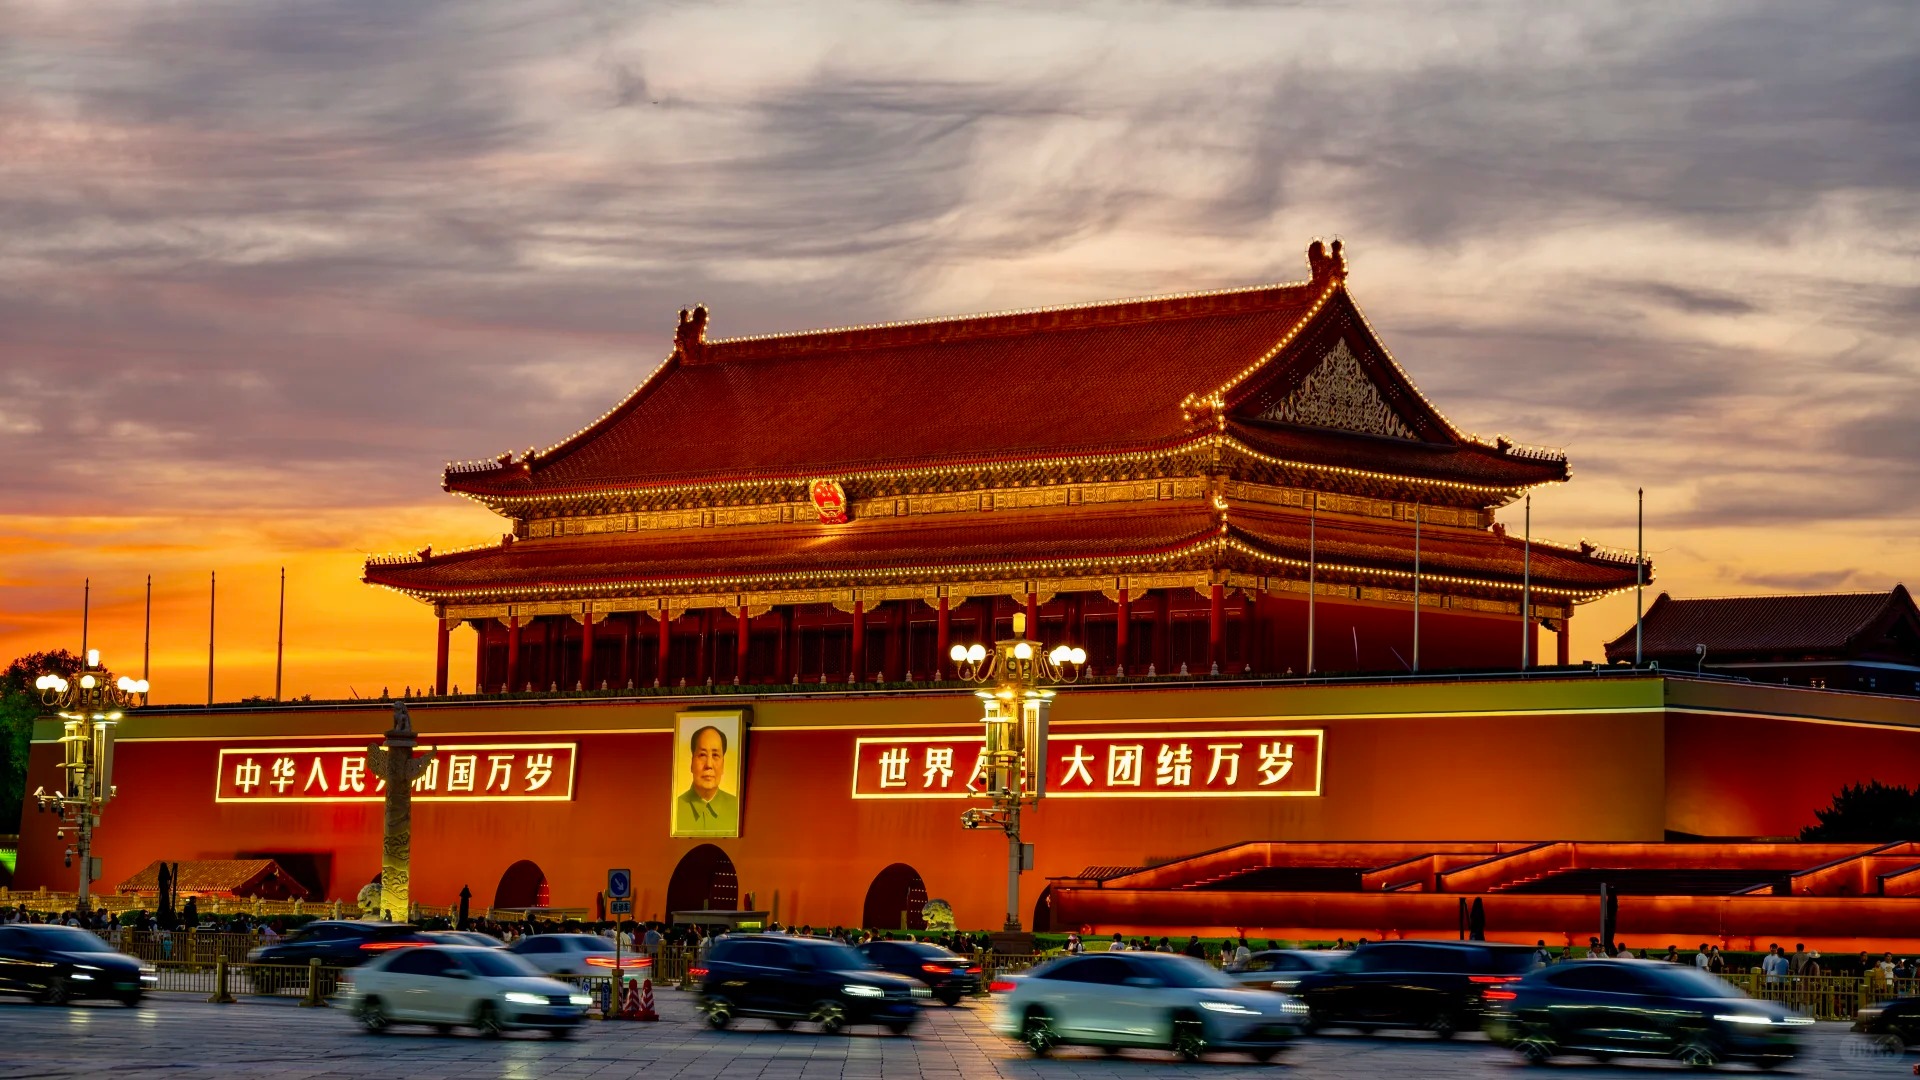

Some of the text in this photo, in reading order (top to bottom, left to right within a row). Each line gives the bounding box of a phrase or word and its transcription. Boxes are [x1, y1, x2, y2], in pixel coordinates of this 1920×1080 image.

[235, 753, 554, 793] 中华人民和国万岁
[878, 742, 1295, 789] 世界大团结万岁
